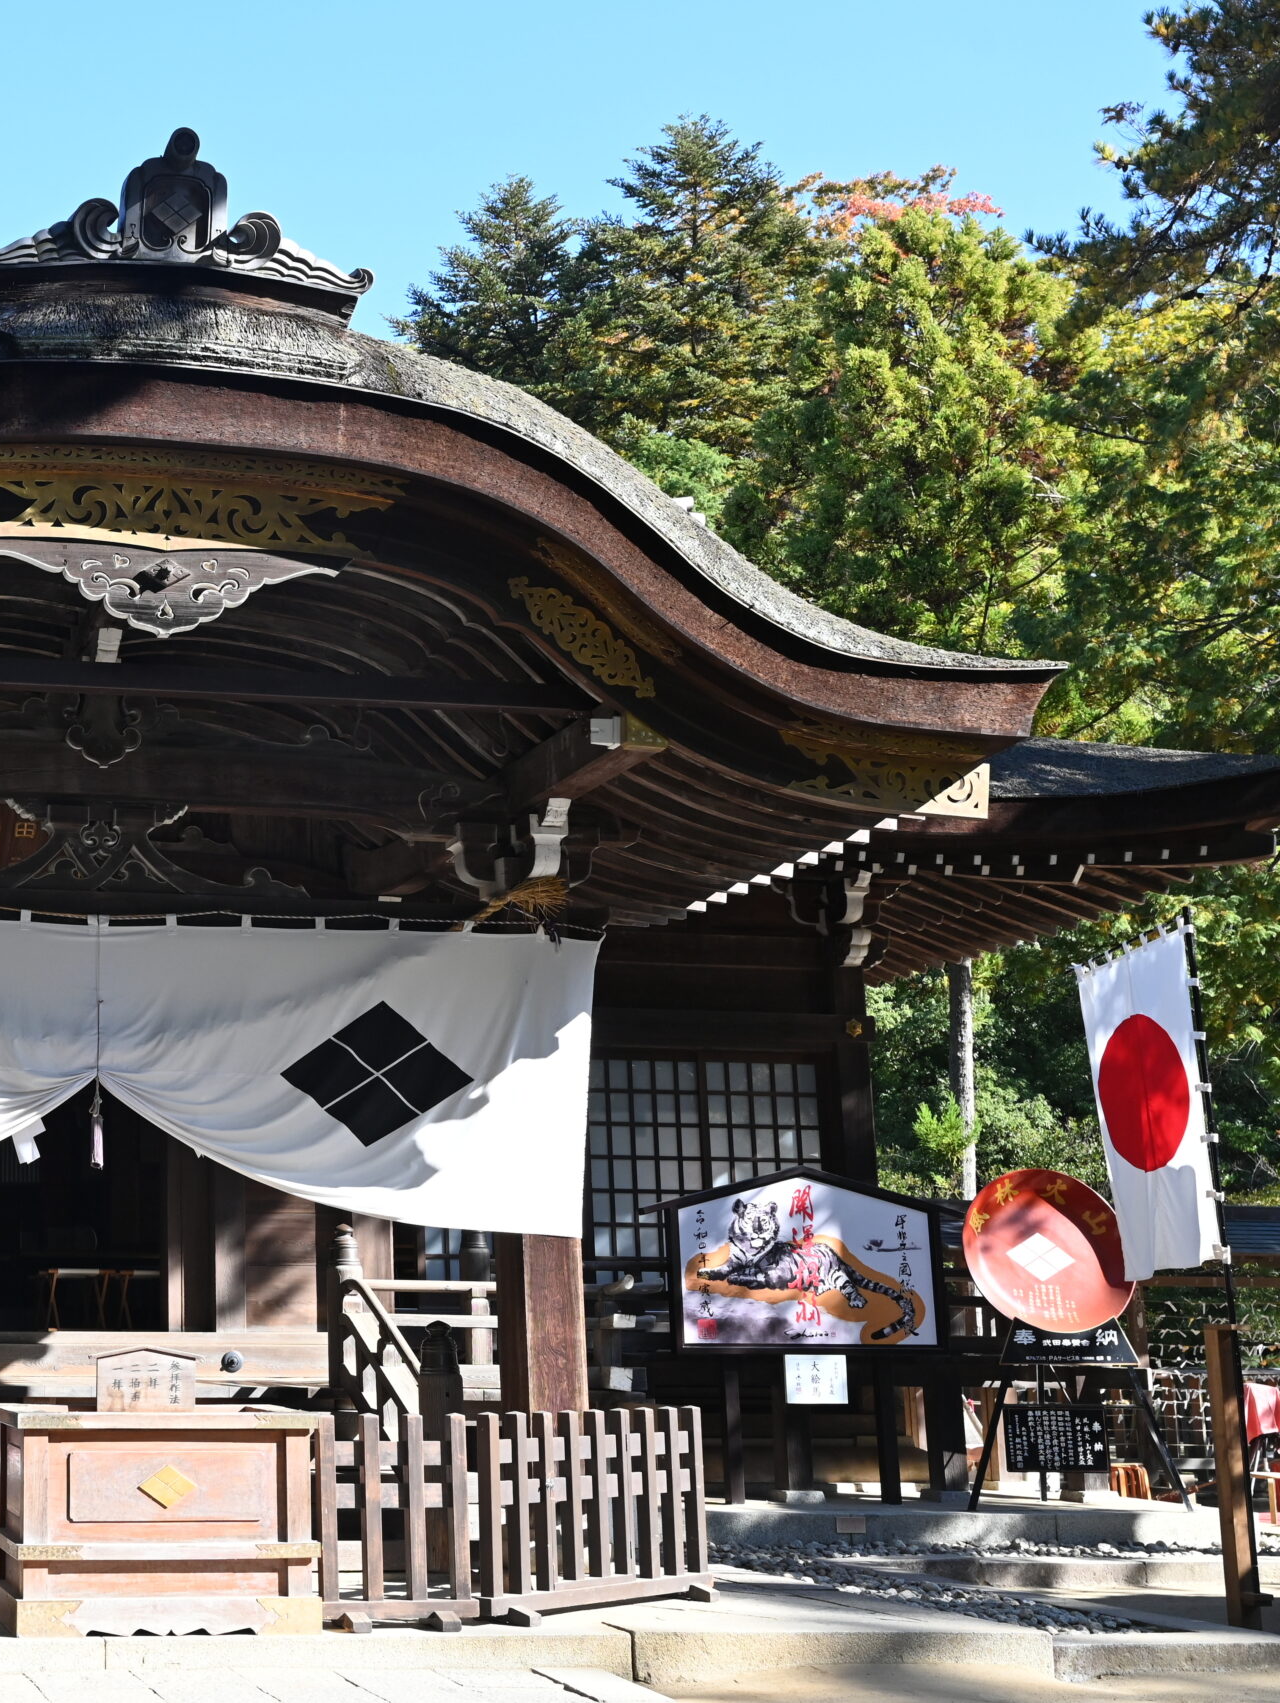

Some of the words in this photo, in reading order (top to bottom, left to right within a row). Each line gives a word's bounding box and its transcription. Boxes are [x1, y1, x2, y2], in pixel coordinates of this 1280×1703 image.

[788, 1184, 822, 1326] 開運招福
[1013, 1328, 1037, 1346] 奉
[1095, 1328, 1119, 1346] 納
[811, 1361, 822, 1397] 大絵馬
